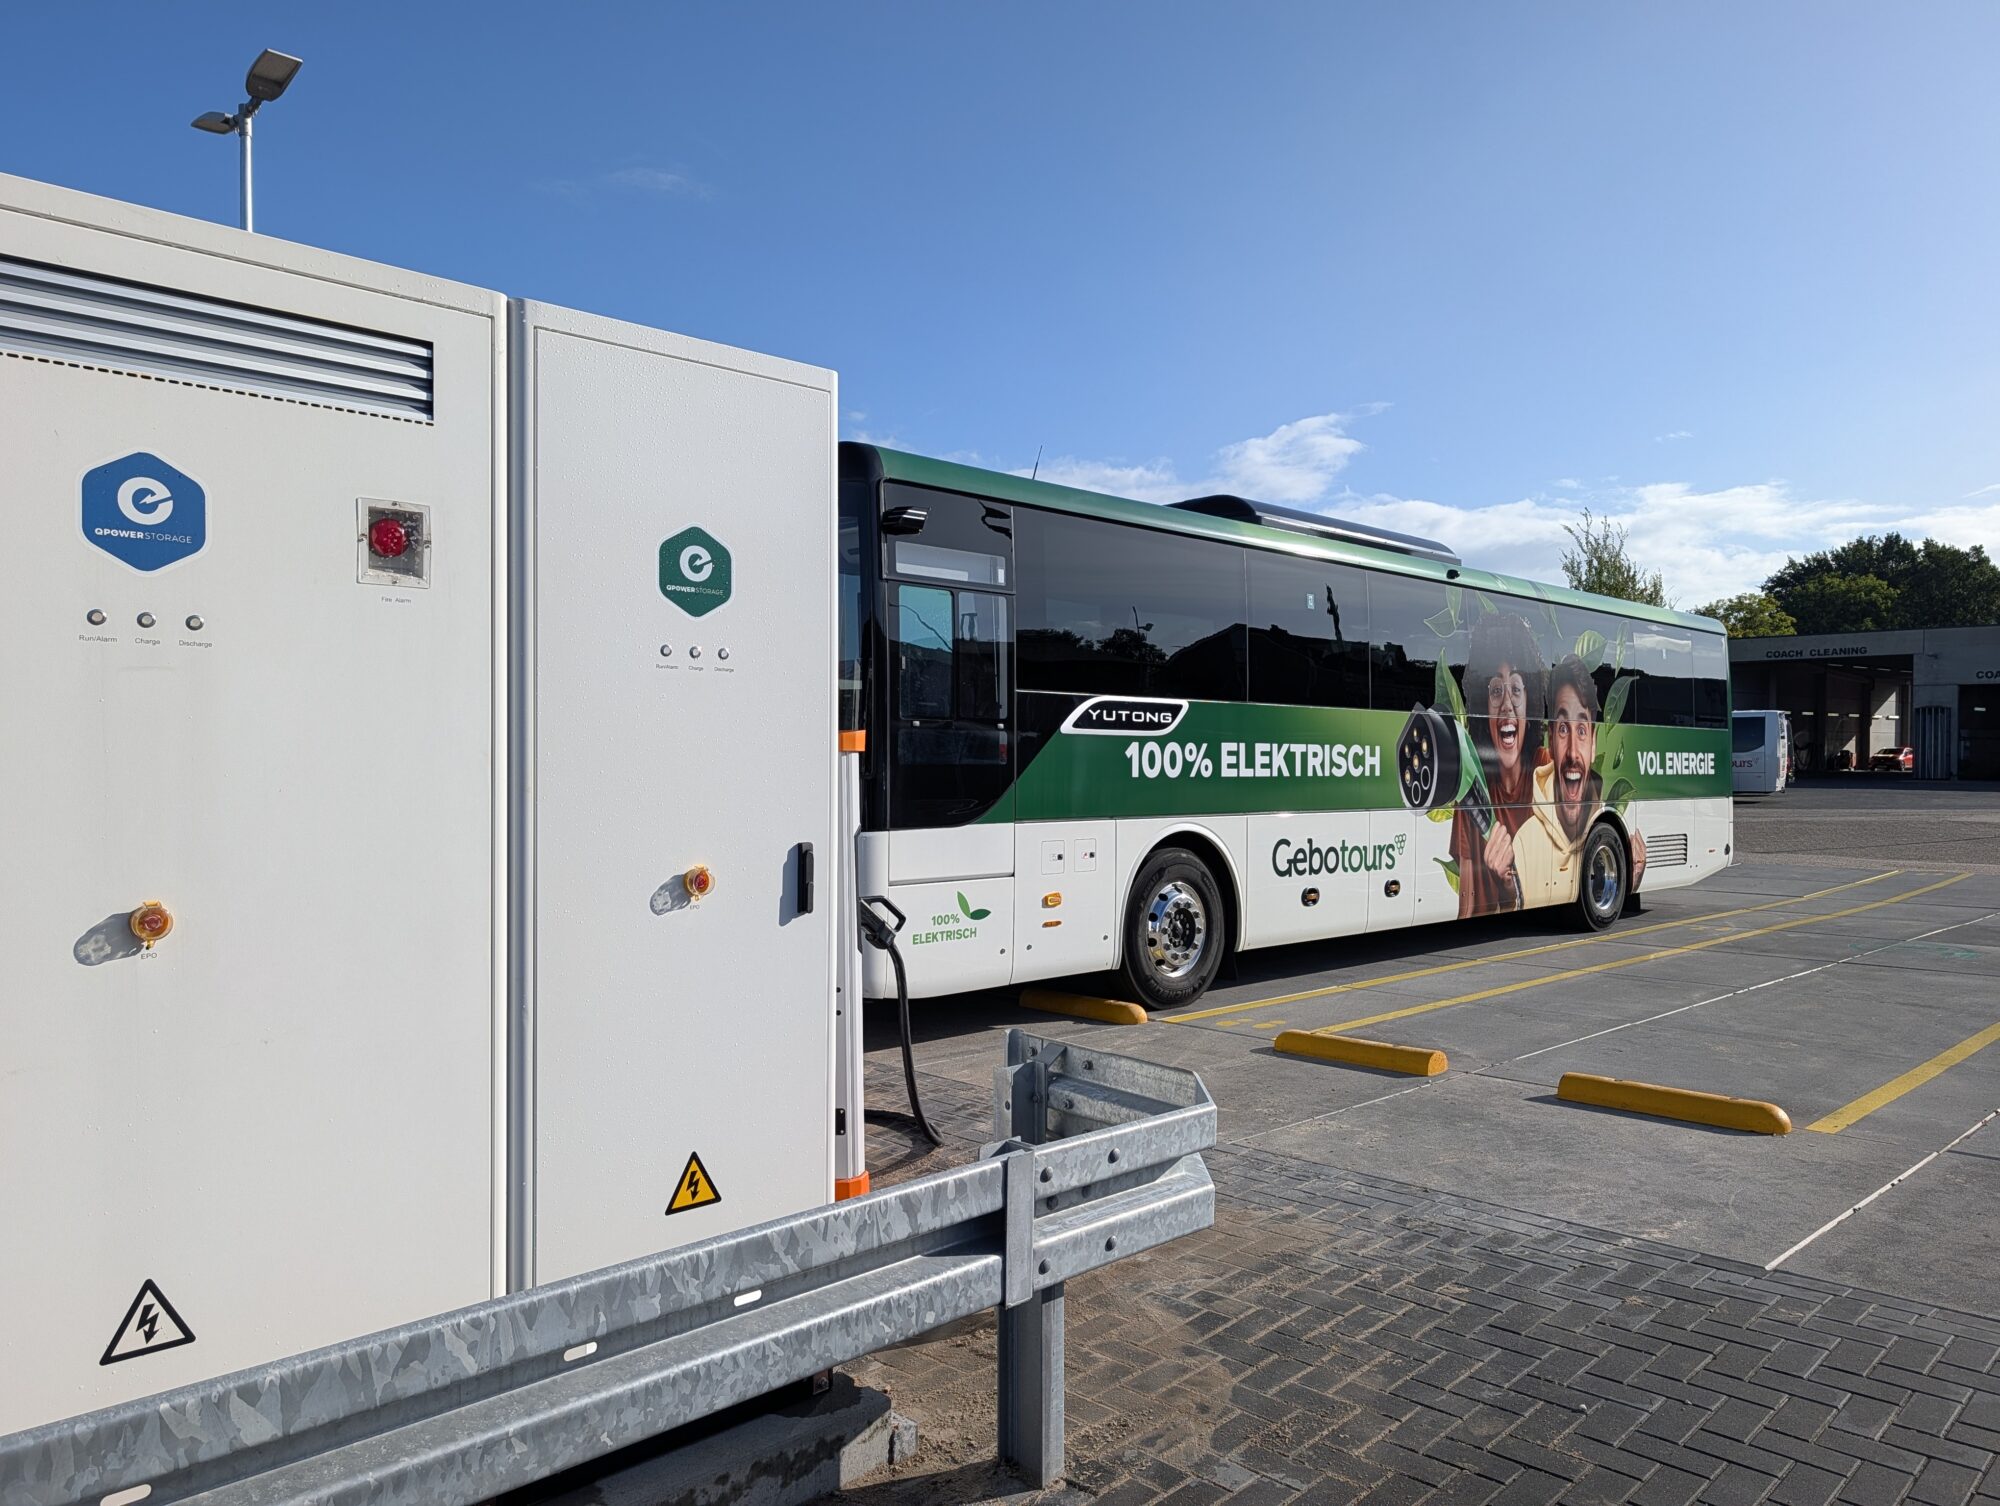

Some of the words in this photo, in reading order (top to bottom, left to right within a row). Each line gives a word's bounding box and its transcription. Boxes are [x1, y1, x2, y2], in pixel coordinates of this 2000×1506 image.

[79, 634, 118, 644] Run/Alarm
[134, 637, 161, 645] Charge
[178, 639, 213, 648] Discharge
[1766, 650, 1803, 659] COACH
[1809, 646, 1867, 657] CLEANING
[1088, 709, 1173, 723] YUTONG
[1125, 741, 1213, 778] 100%
[1221, 742, 1381, 778] ELEKTRISCH
[1637, 751, 1664, 776] VOL
[1665, 752, 1715, 775] ENERGIE
[1272, 838, 1396, 877] Gebotours
[931, 913, 960, 926] 100%
[912, 927, 977, 945] ELEKTRISCH
[140, 952, 158, 960] EPO
